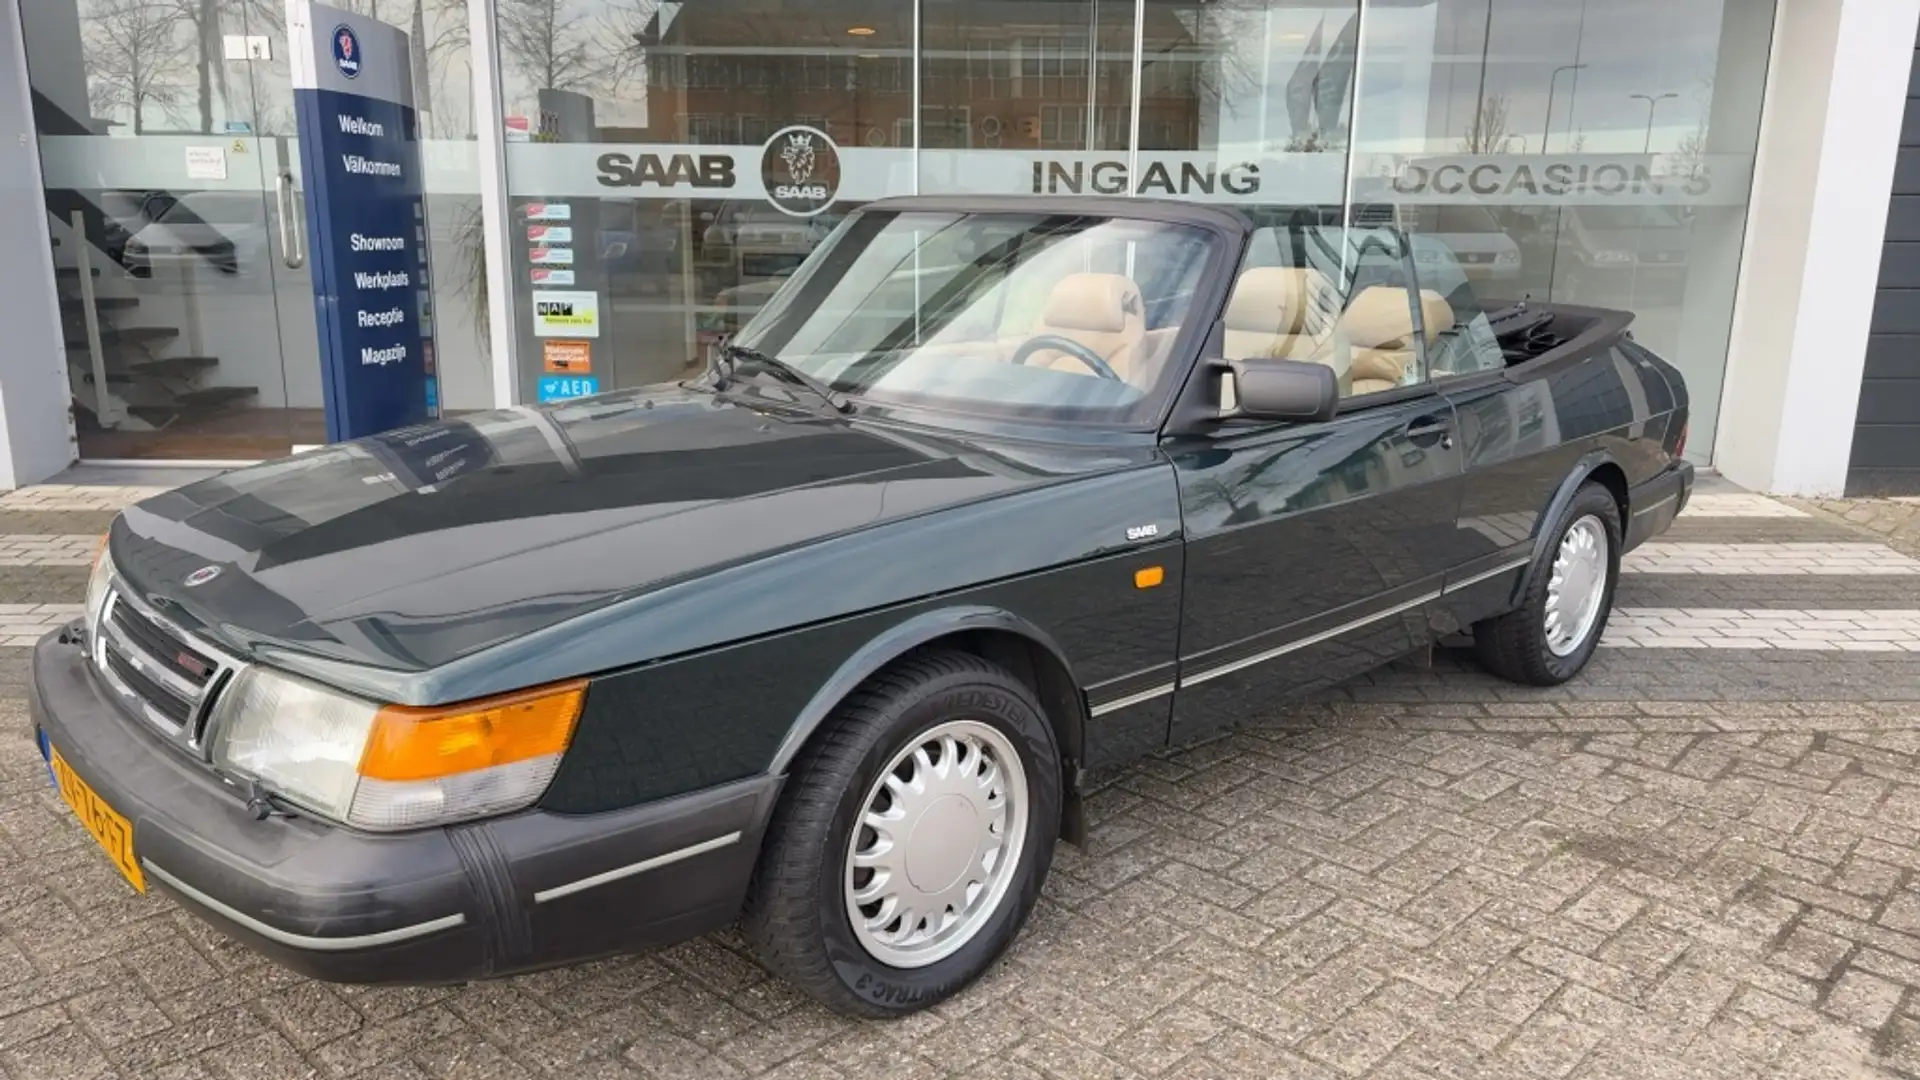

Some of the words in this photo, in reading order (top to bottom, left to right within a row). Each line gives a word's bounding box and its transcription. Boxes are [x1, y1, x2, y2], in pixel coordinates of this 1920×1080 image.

[338, 114, 384, 136] Welkom
[342, 154, 401, 176] Välkommen
[597, 153, 736, 188] SAAB
[1032, 161, 1261, 195] INGANG
[775, 185, 827, 200] SAAB
[350, 233, 405, 251] Showroom
[354, 270, 409, 291] Werkplaats
[358, 306, 404, 327] Receptie
[361, 343, 406, 365] Magazijn
[561, 380, 591, 396] AED
